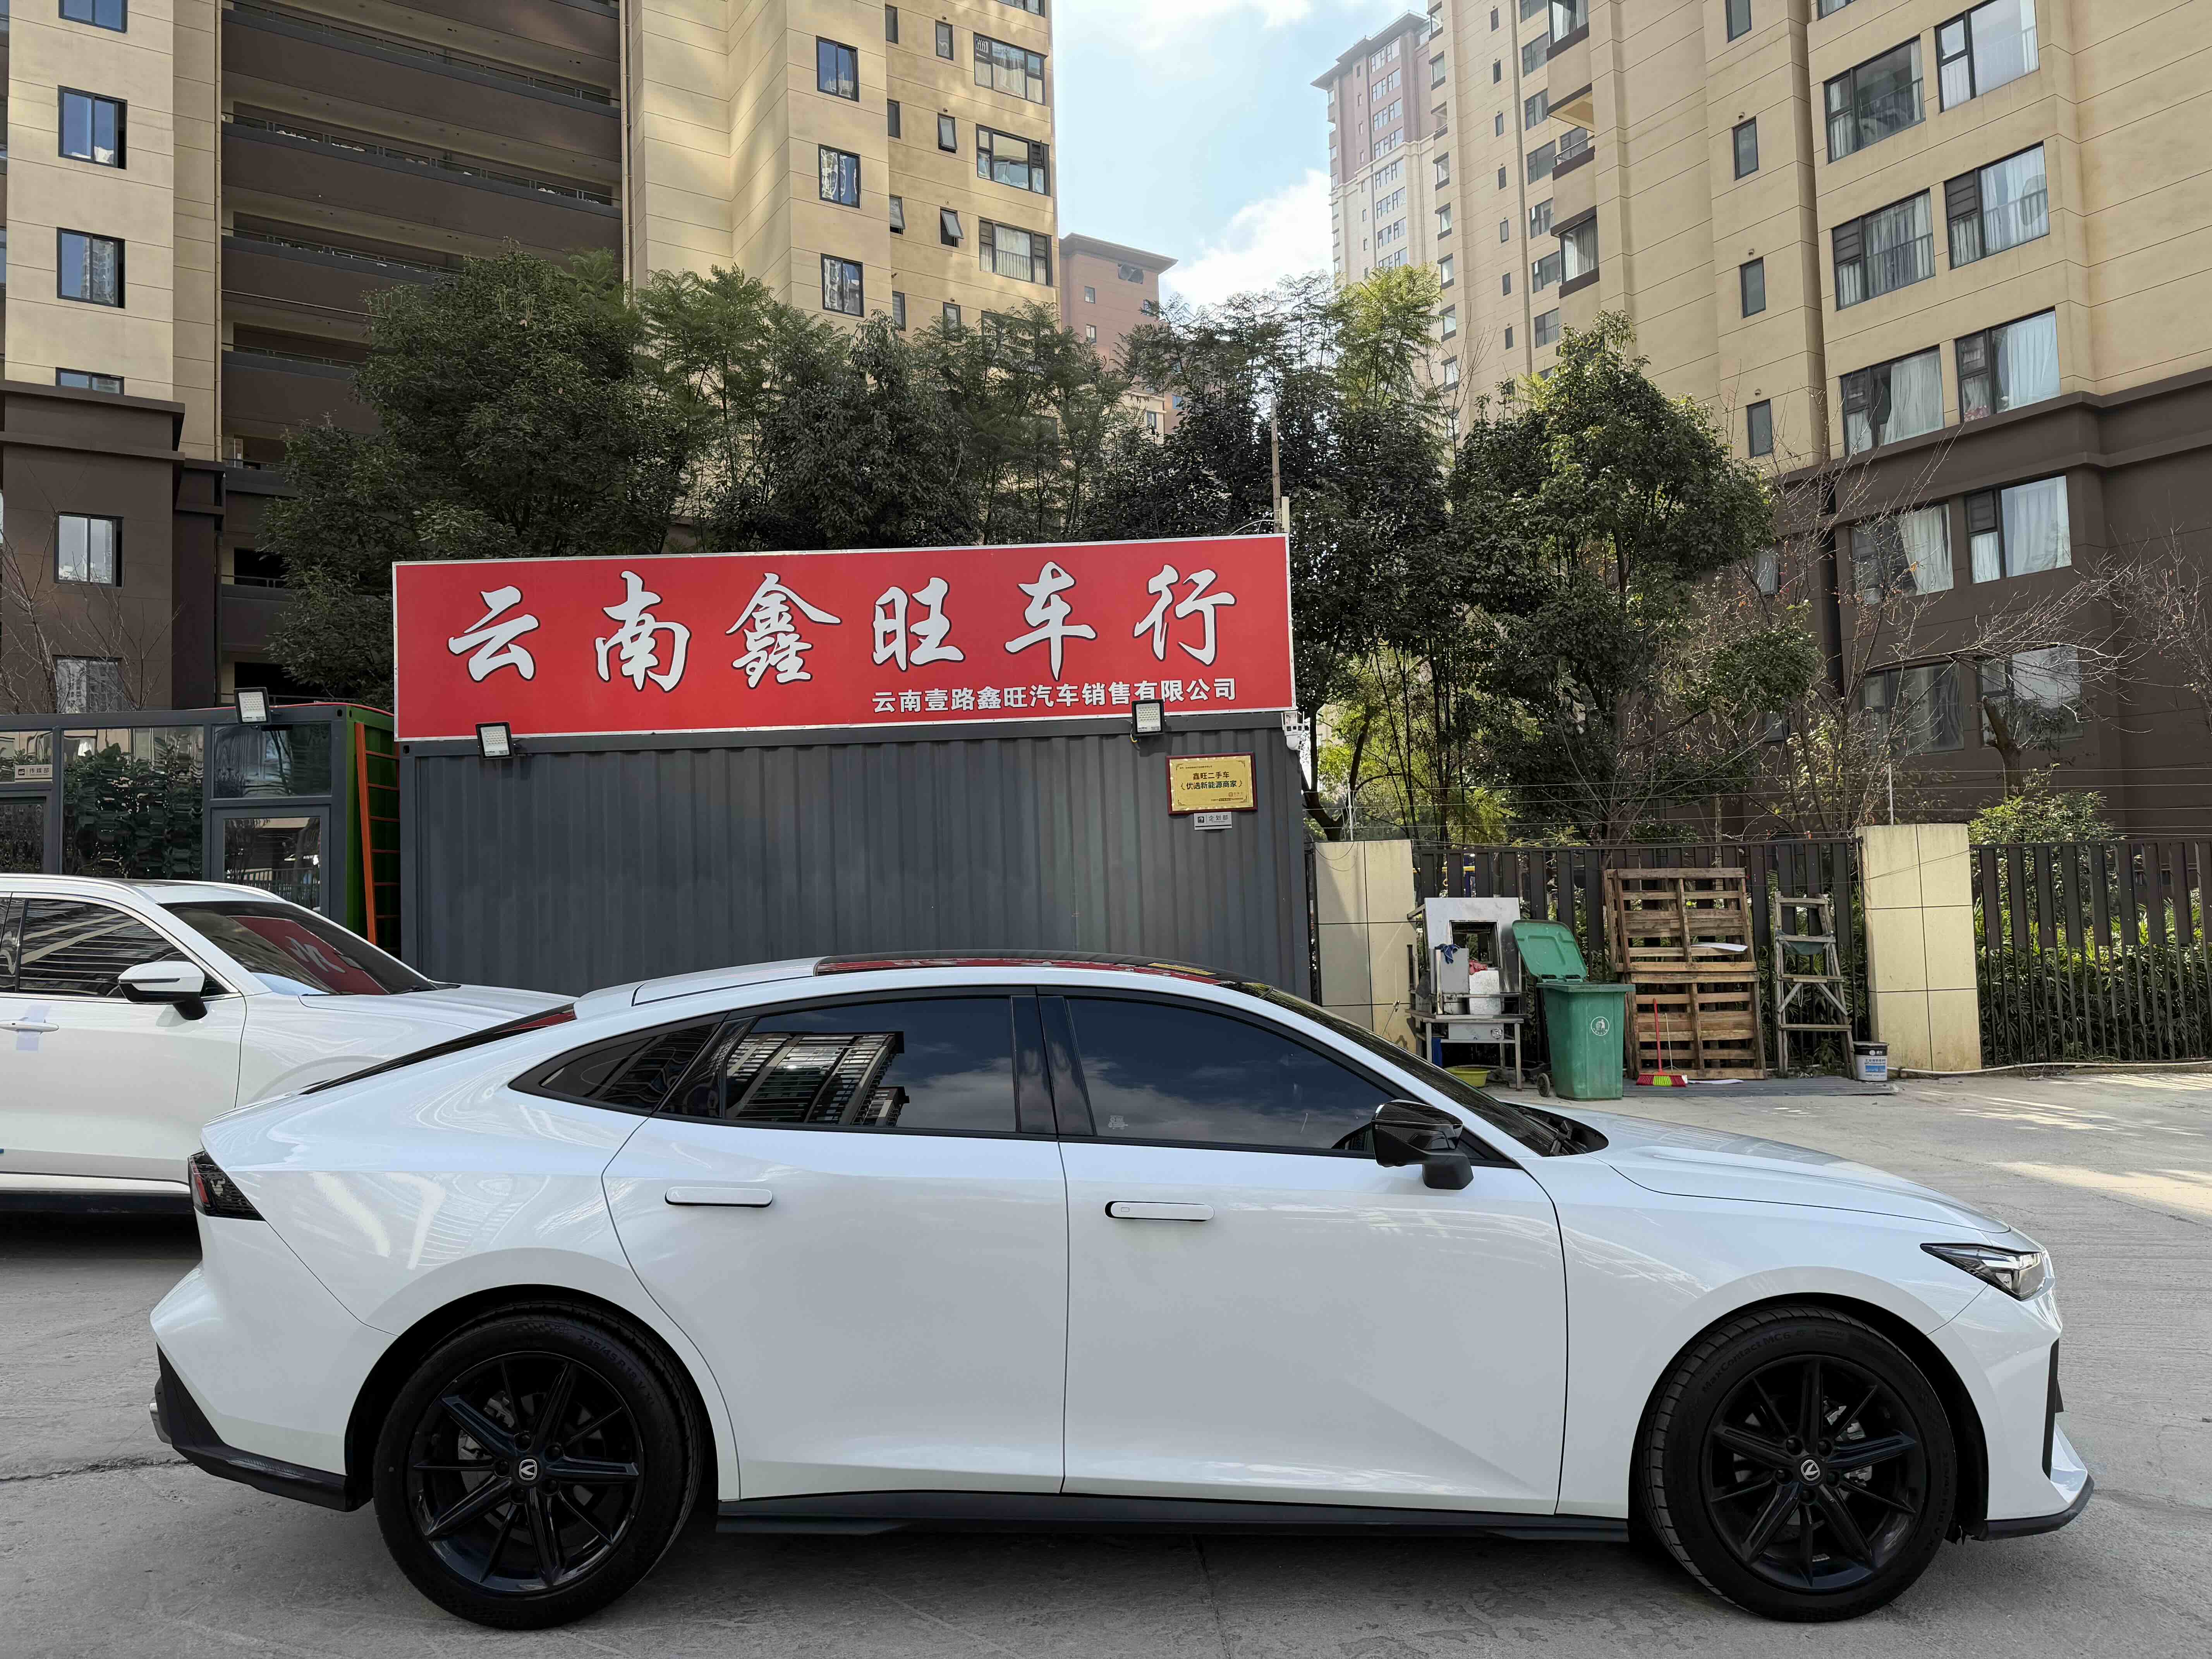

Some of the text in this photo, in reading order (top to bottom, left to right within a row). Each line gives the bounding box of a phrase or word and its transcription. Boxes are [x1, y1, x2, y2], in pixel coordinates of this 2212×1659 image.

[448, 561, 1236, 692] 云南鑫旺车行
[872, 678, 1235, 713] 云南壹路鑫旺汽车销售有限公司
[1186, 780, 1237, 790] 优选新能源商家
[1193, 771, 1230, 780] 鑫旺二手车
[1702, 1331, 1791, 1393] MaxContact MC6
